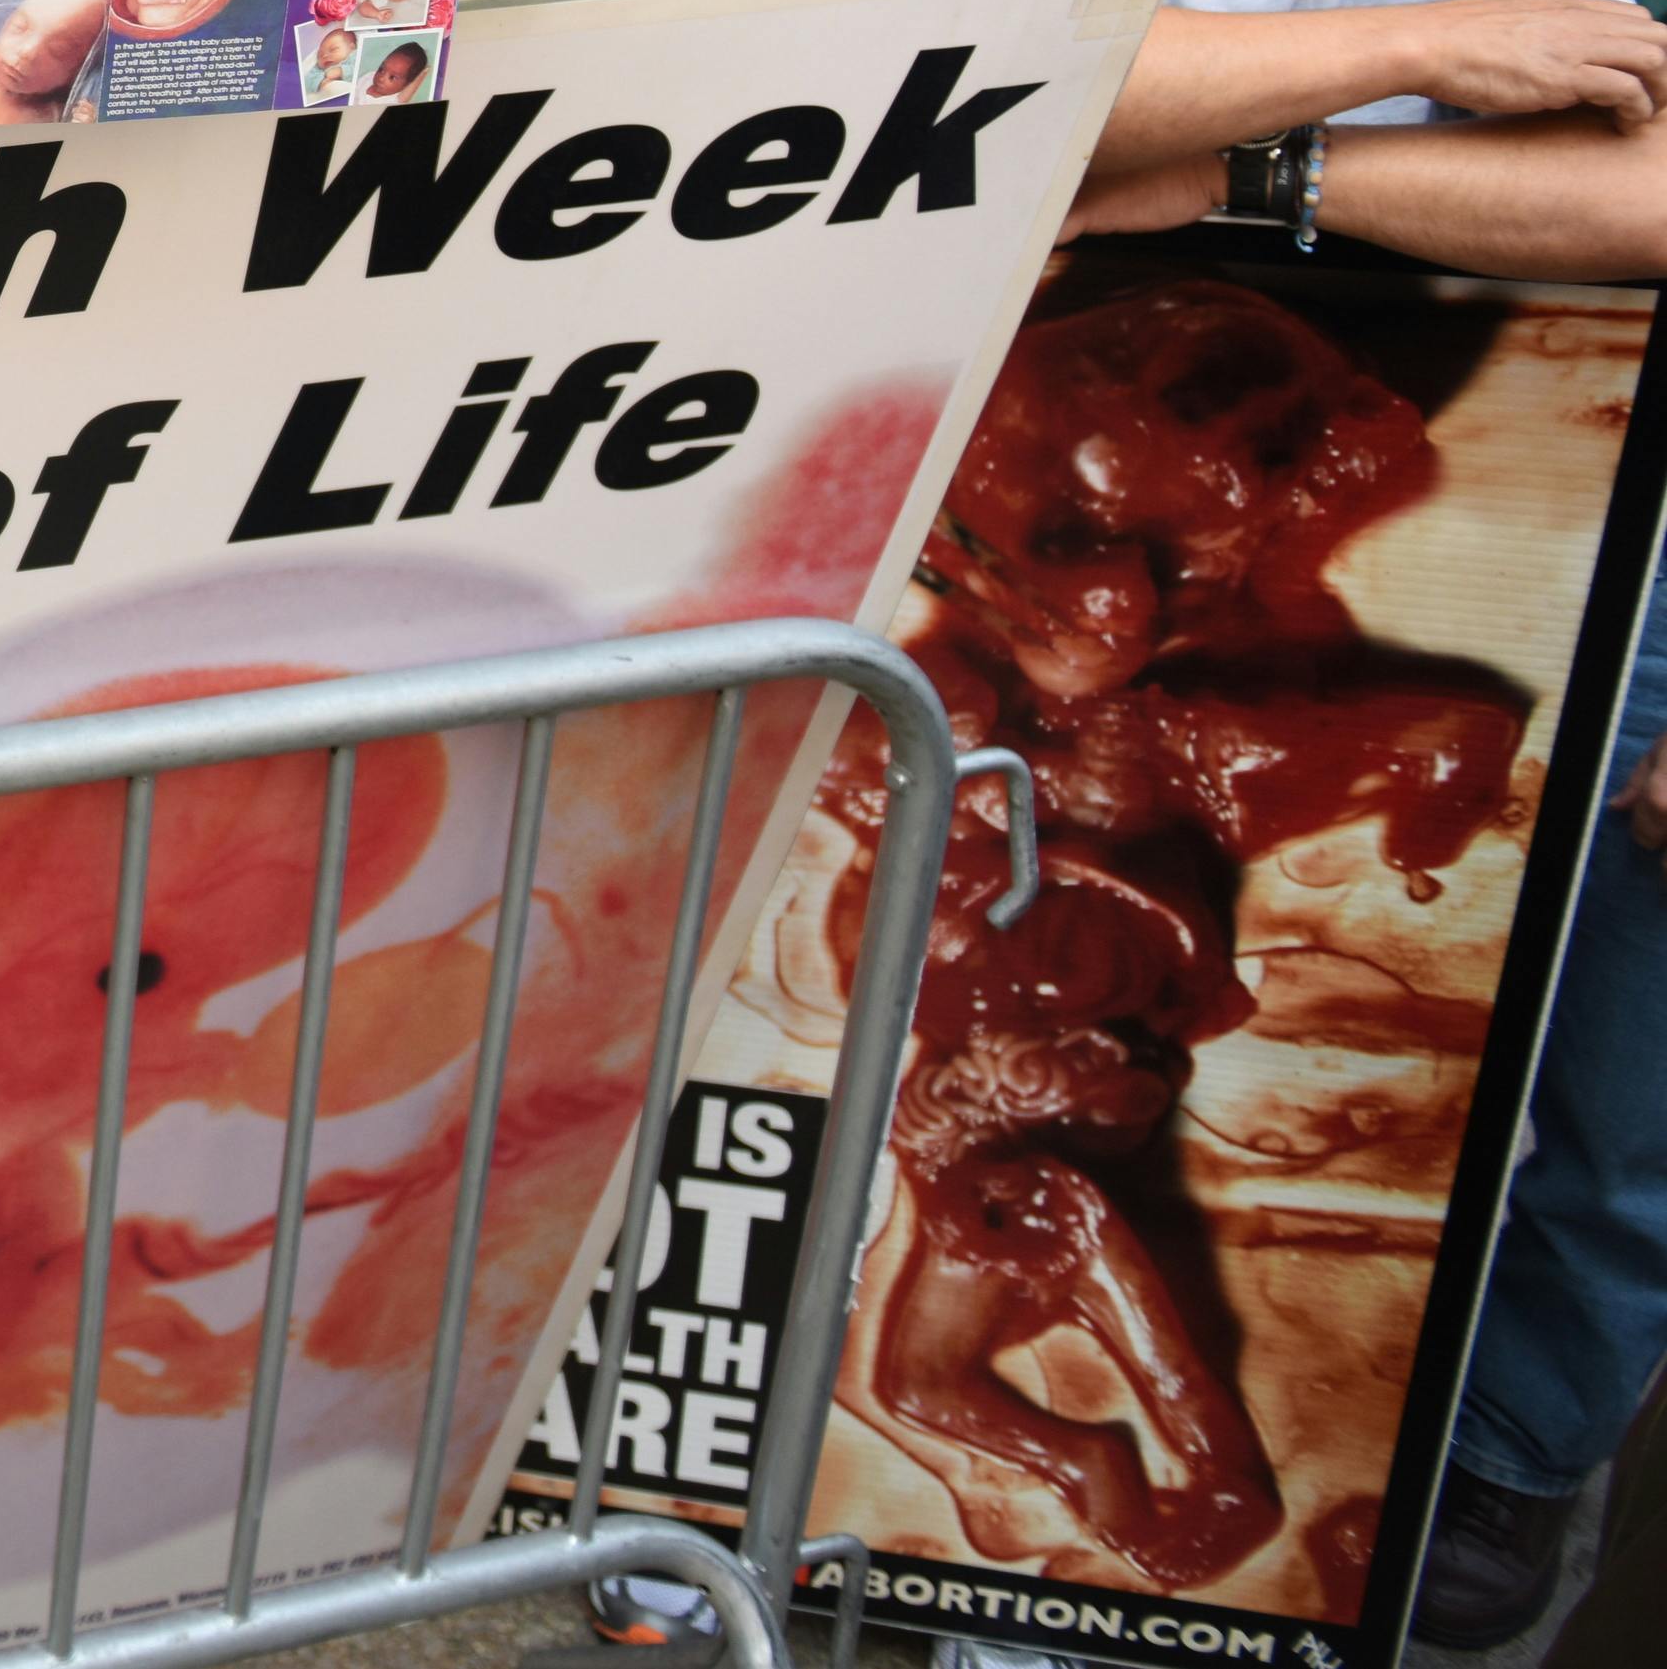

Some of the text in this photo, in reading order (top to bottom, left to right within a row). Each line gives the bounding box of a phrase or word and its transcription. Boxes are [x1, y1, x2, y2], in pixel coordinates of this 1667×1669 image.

[162, 40, 187, 48] months
[201, 39, 220, 47] baby
[221, 37, 254, 45] continues
[242, 45, 1047, 294] Week
[225, 339, 762, 545] Life
[693, 1095, 794, 1179] IS
